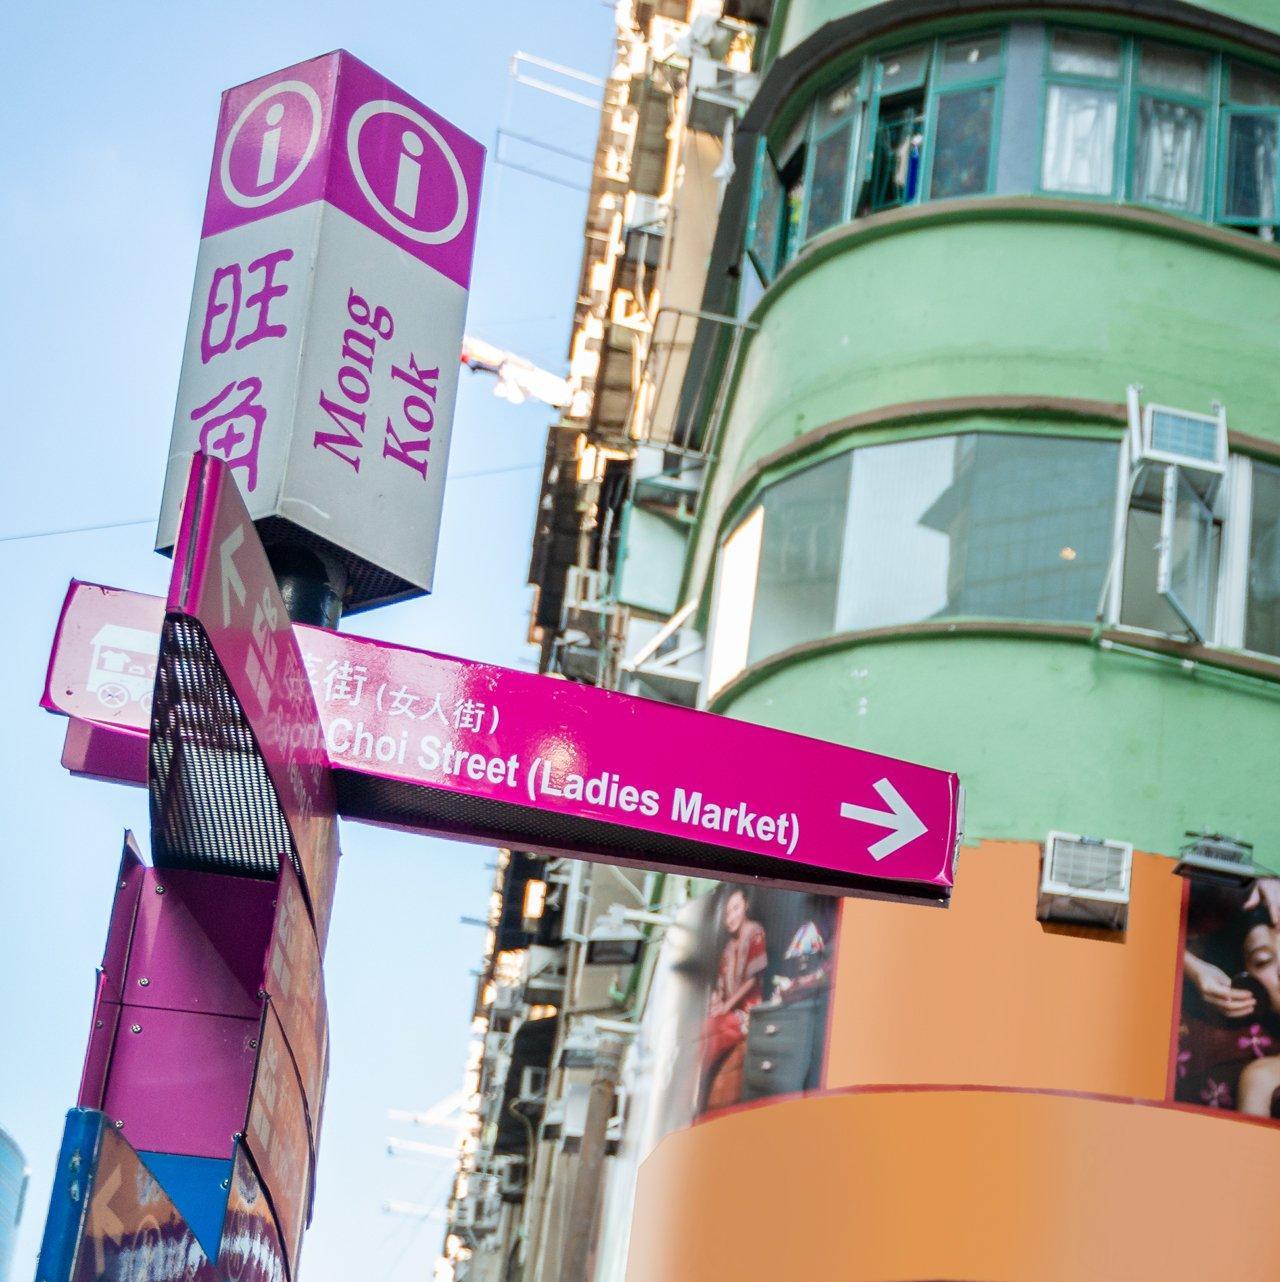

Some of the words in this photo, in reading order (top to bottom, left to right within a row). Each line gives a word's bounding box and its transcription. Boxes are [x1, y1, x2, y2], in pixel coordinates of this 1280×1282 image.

[191, 249, 295, 493] 旺角
[314, 287, 395, 475] Mong
[382, 352, 440, 482] Kok
[375, 682, 500, 735] (女人街)
[328, 717, 409, 764] Choi
[417, 734, 520, 788] Street
[527, 757, 661, 817] (Ladies
[670, 786, 800, 856] Market)
